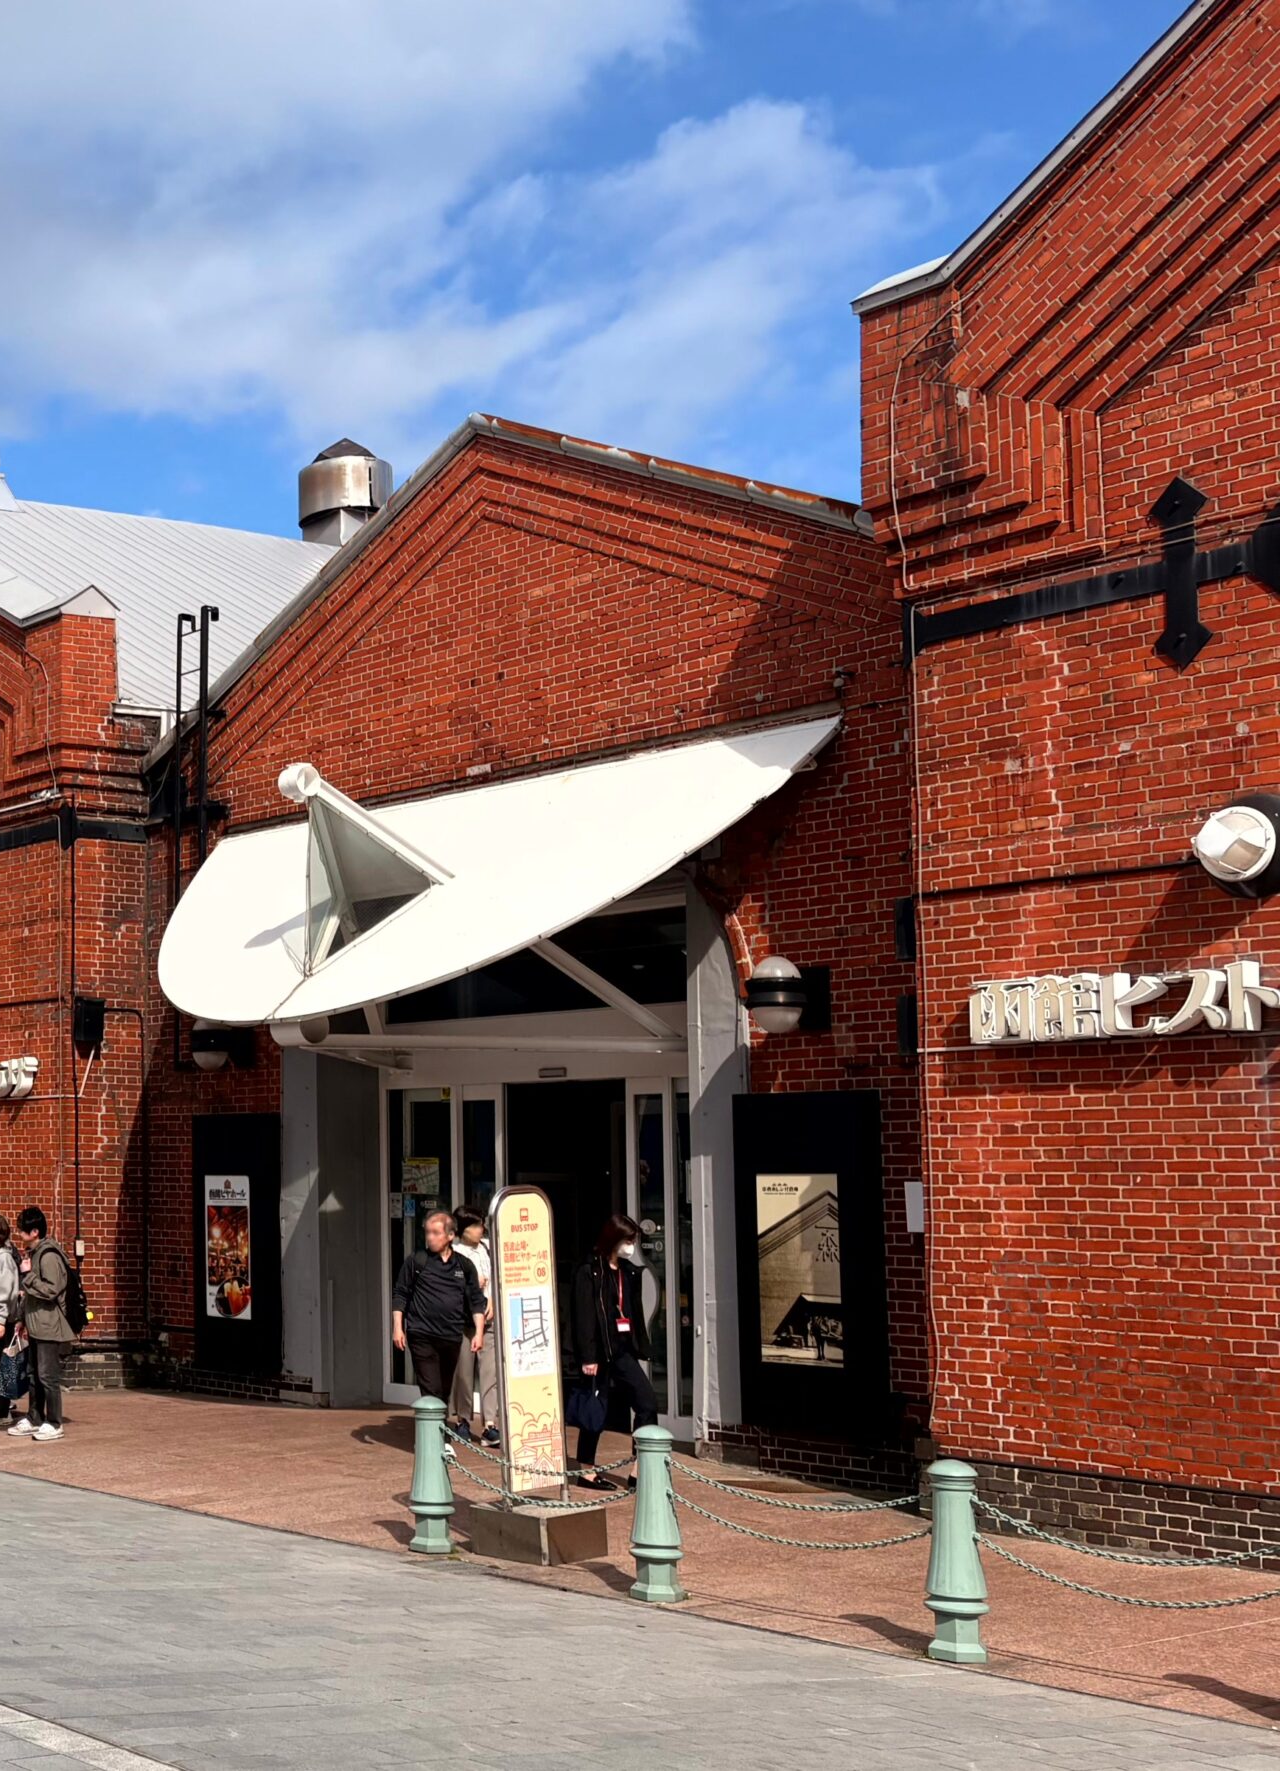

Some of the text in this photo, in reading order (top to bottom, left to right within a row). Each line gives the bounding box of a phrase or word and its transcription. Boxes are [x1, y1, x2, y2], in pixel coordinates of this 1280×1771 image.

[970, 960, 1280, 1044] 函館ヒスト
[511, 1223, 538, 1232] BUS STOP
[536, 1267, 546, 1277] 08
